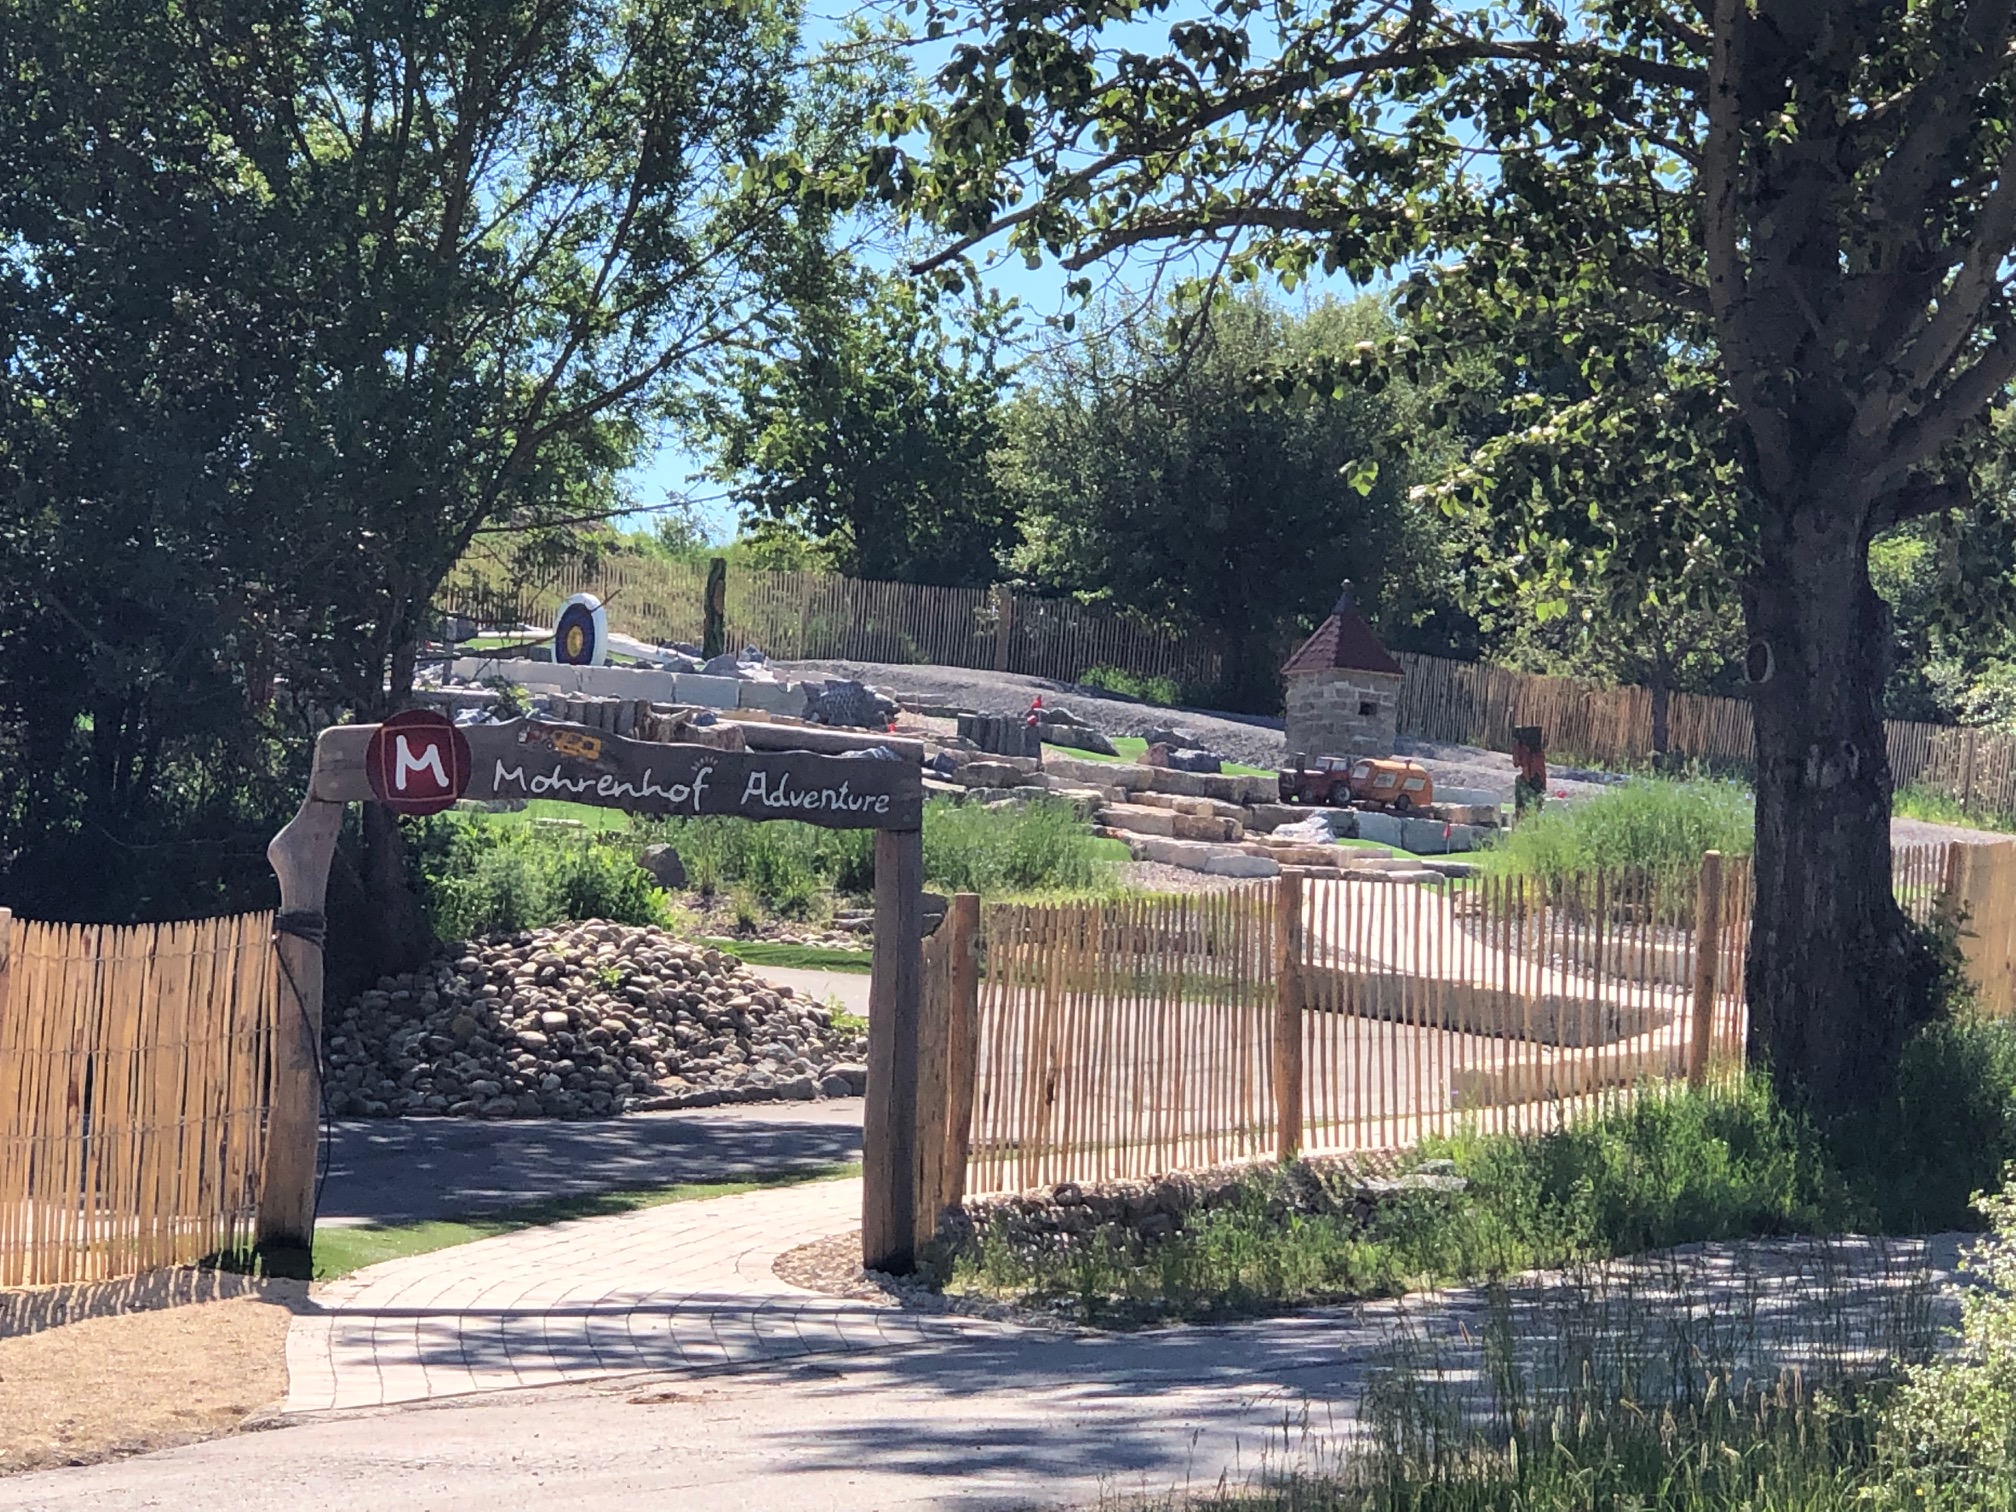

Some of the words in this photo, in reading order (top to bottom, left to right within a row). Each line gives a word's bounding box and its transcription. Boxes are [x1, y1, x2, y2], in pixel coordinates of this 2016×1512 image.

[394, 735, 450, 790] M
[493, 758, 713, 811] Mohrenhof
[741, 771, 891, 813] Adventure
